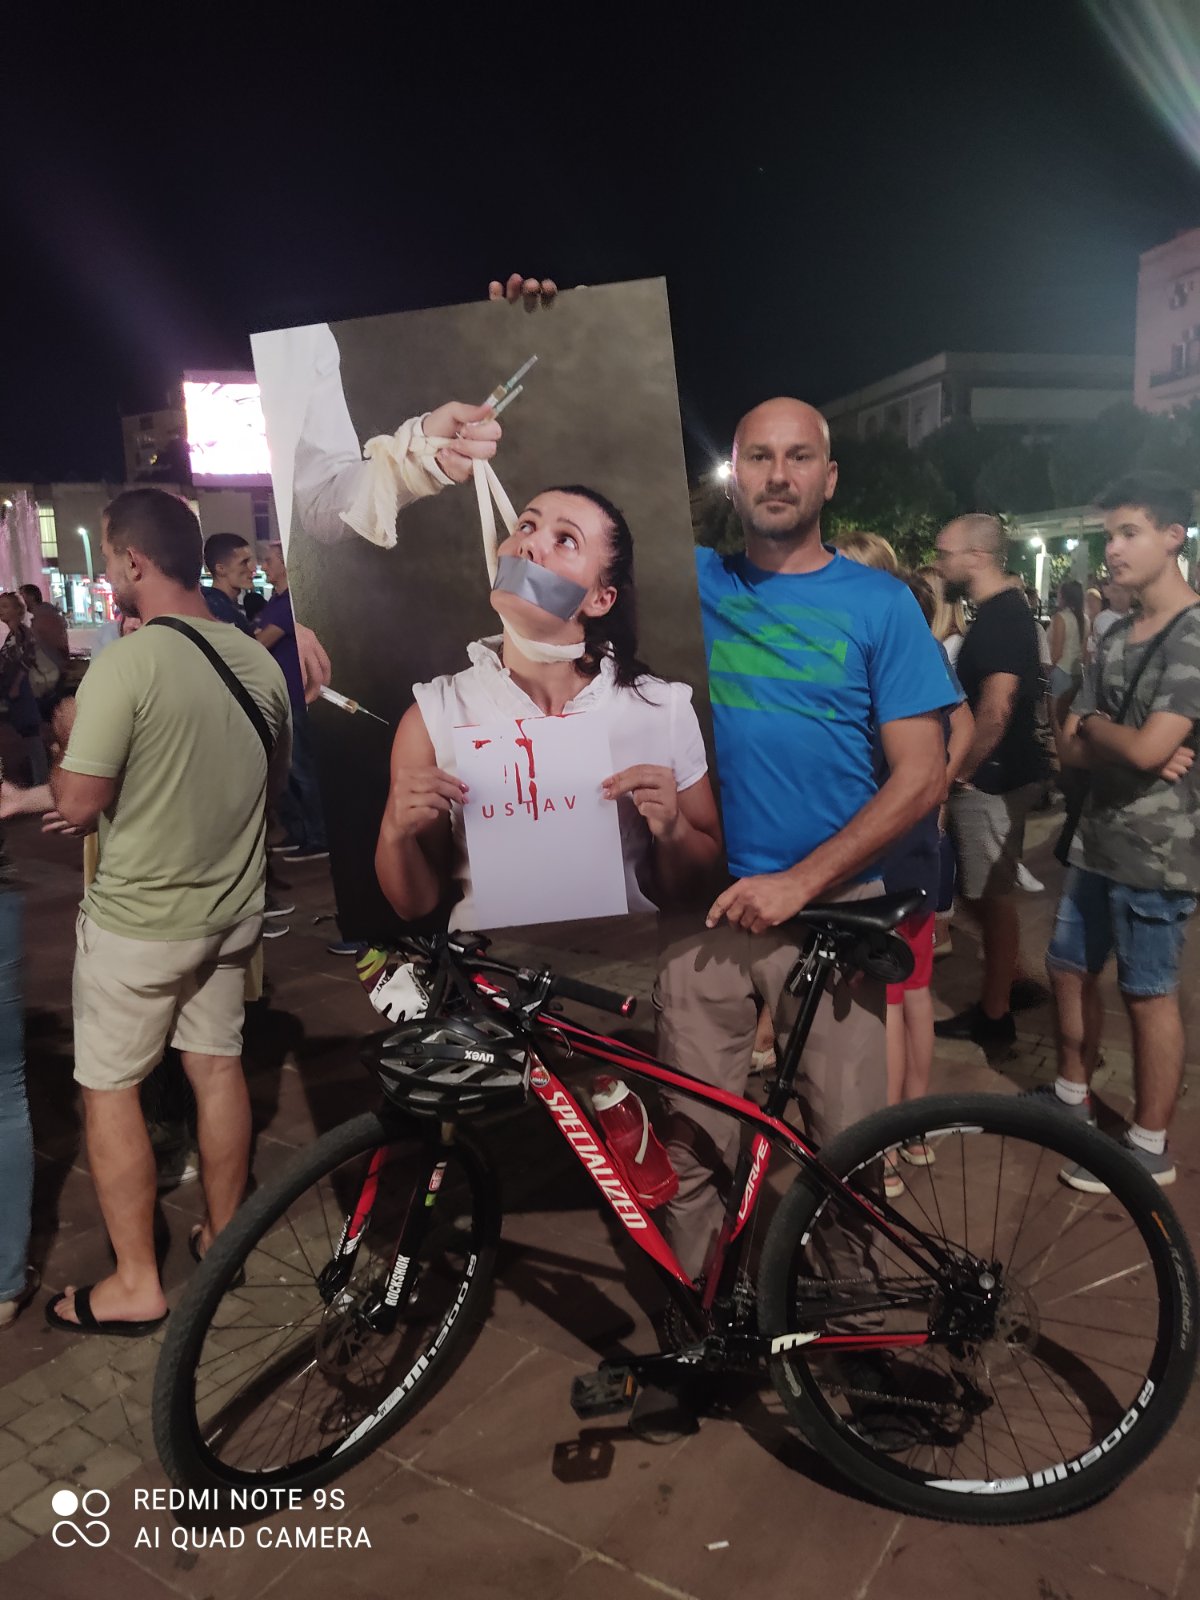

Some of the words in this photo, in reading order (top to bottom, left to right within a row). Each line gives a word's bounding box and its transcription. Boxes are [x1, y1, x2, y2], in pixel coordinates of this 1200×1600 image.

[482, 795, 576, 819] USTAV
[464, 1050, 495, 1063] uvex
[539, 1090, 648, 1229] SPECIALIZED
[738, 1137, 769, 1221] CARVE
[385, 1253, 411, 1307] ROCKSHOX
